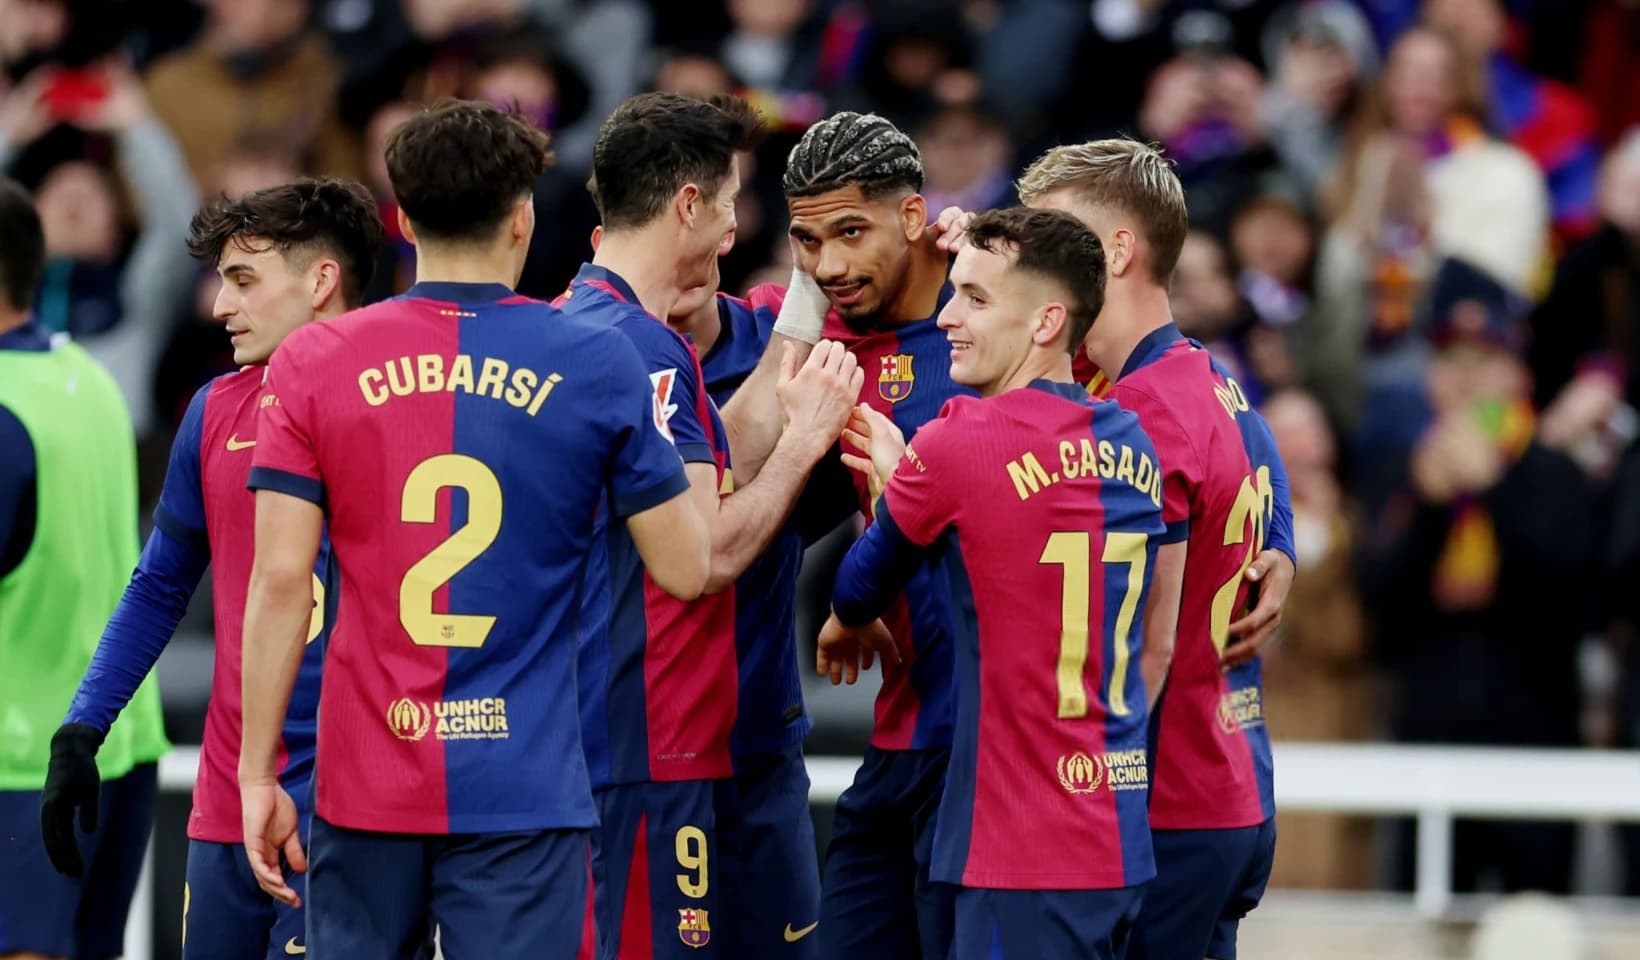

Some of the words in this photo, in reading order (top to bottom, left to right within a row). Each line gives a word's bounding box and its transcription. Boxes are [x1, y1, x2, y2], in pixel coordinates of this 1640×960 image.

[358, 353, 564, 417] CUBARSÍ
[399, 453, 504, 649] 2
[1038, 531, 1149, 718] 17
[434, 698, 505, 717] UNHCR
[435, 715, 508, 733] ACNUR
[1103, 749, 1147, 768] UNHCR
[1107, 766, 1148, 784] ACNUR
[675, 825, 709, 899] 9
